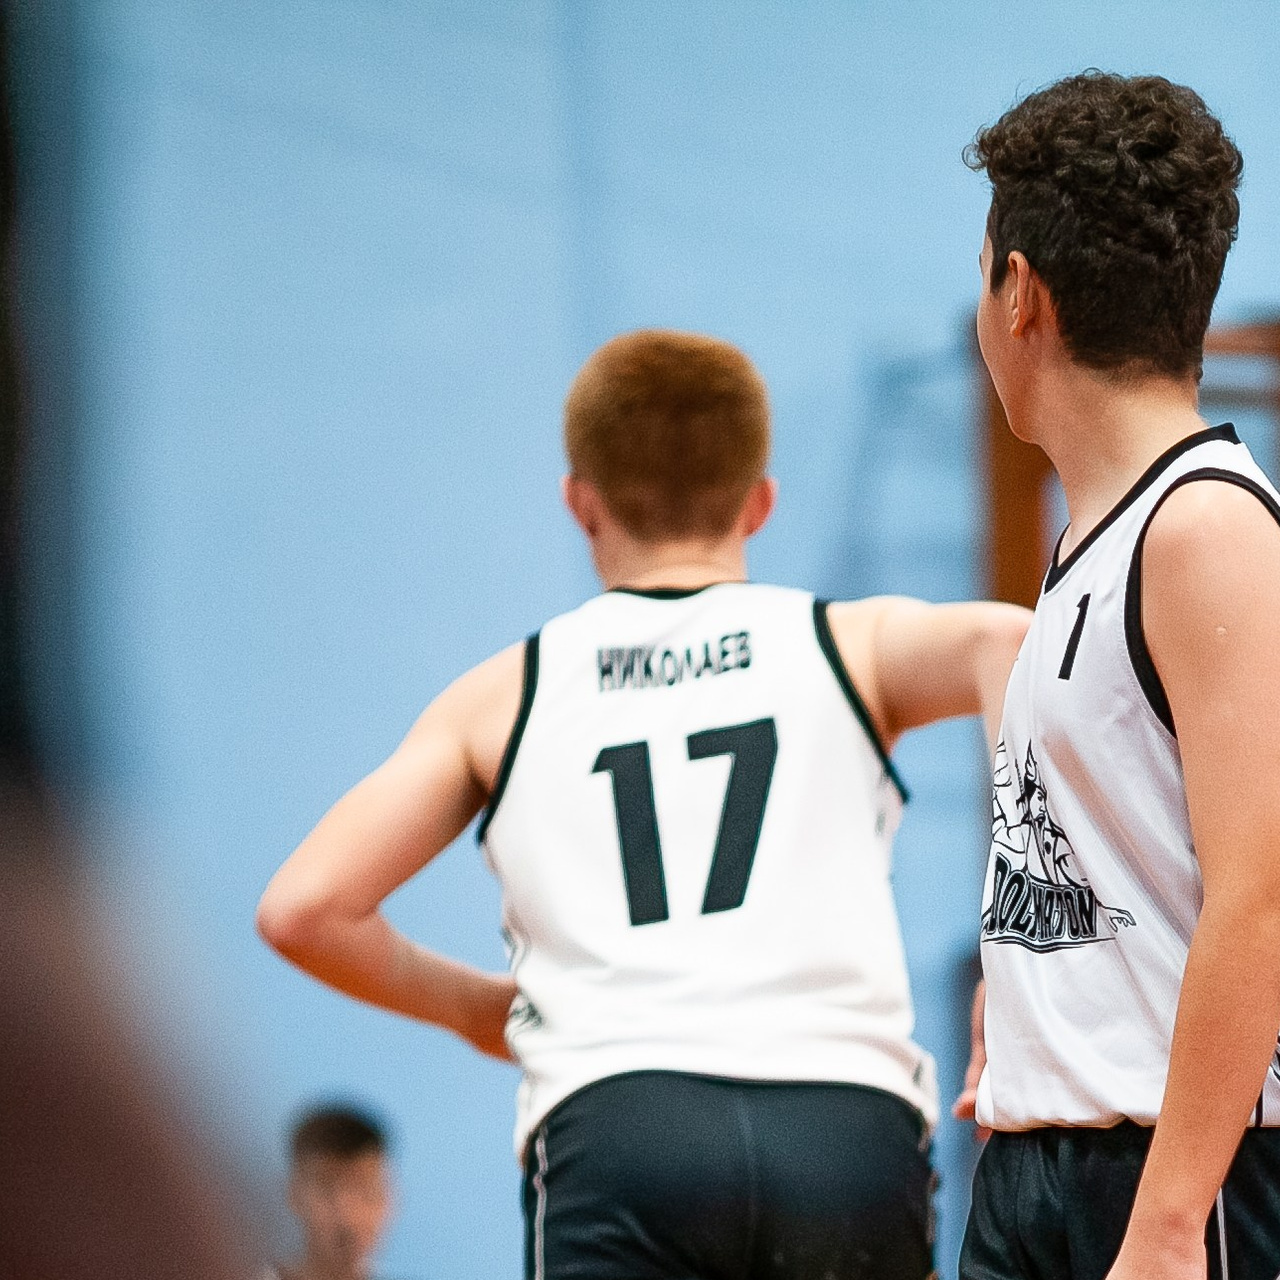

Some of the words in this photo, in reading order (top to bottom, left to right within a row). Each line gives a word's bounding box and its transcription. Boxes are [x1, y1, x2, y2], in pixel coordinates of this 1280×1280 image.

[597, 629, 751, 692] НИКОЛАЕВ
[1058, 593, 1091, 680] 1
[592, 717, 778, 926] 17
